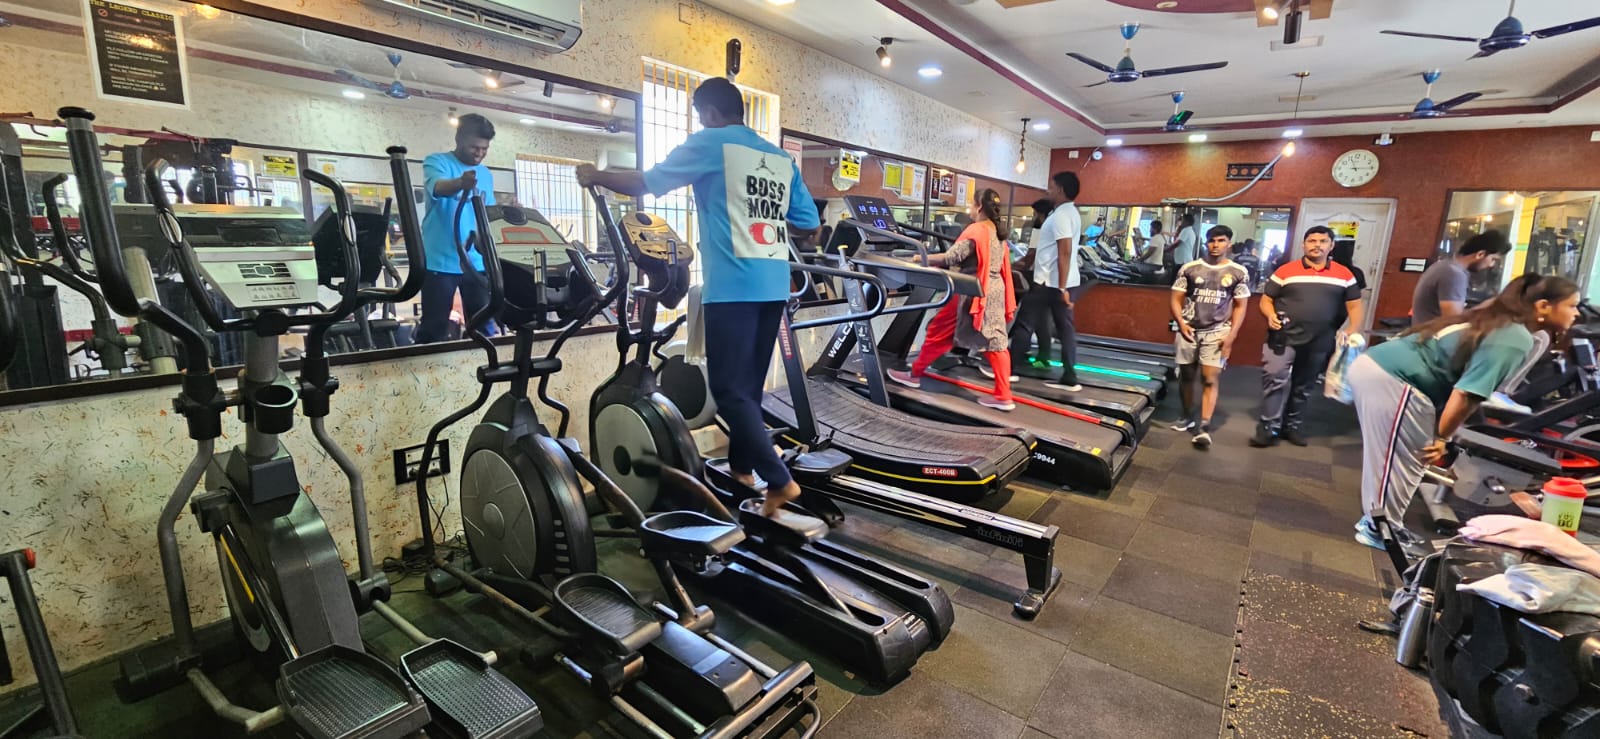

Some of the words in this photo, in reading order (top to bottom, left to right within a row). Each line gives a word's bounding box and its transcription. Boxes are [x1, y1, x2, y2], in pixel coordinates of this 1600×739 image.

[109, 3, 138, 14] LEGEND
[141, 9, 174, 20] CLASSIC
[746, 174, 785, 202] BOSS
